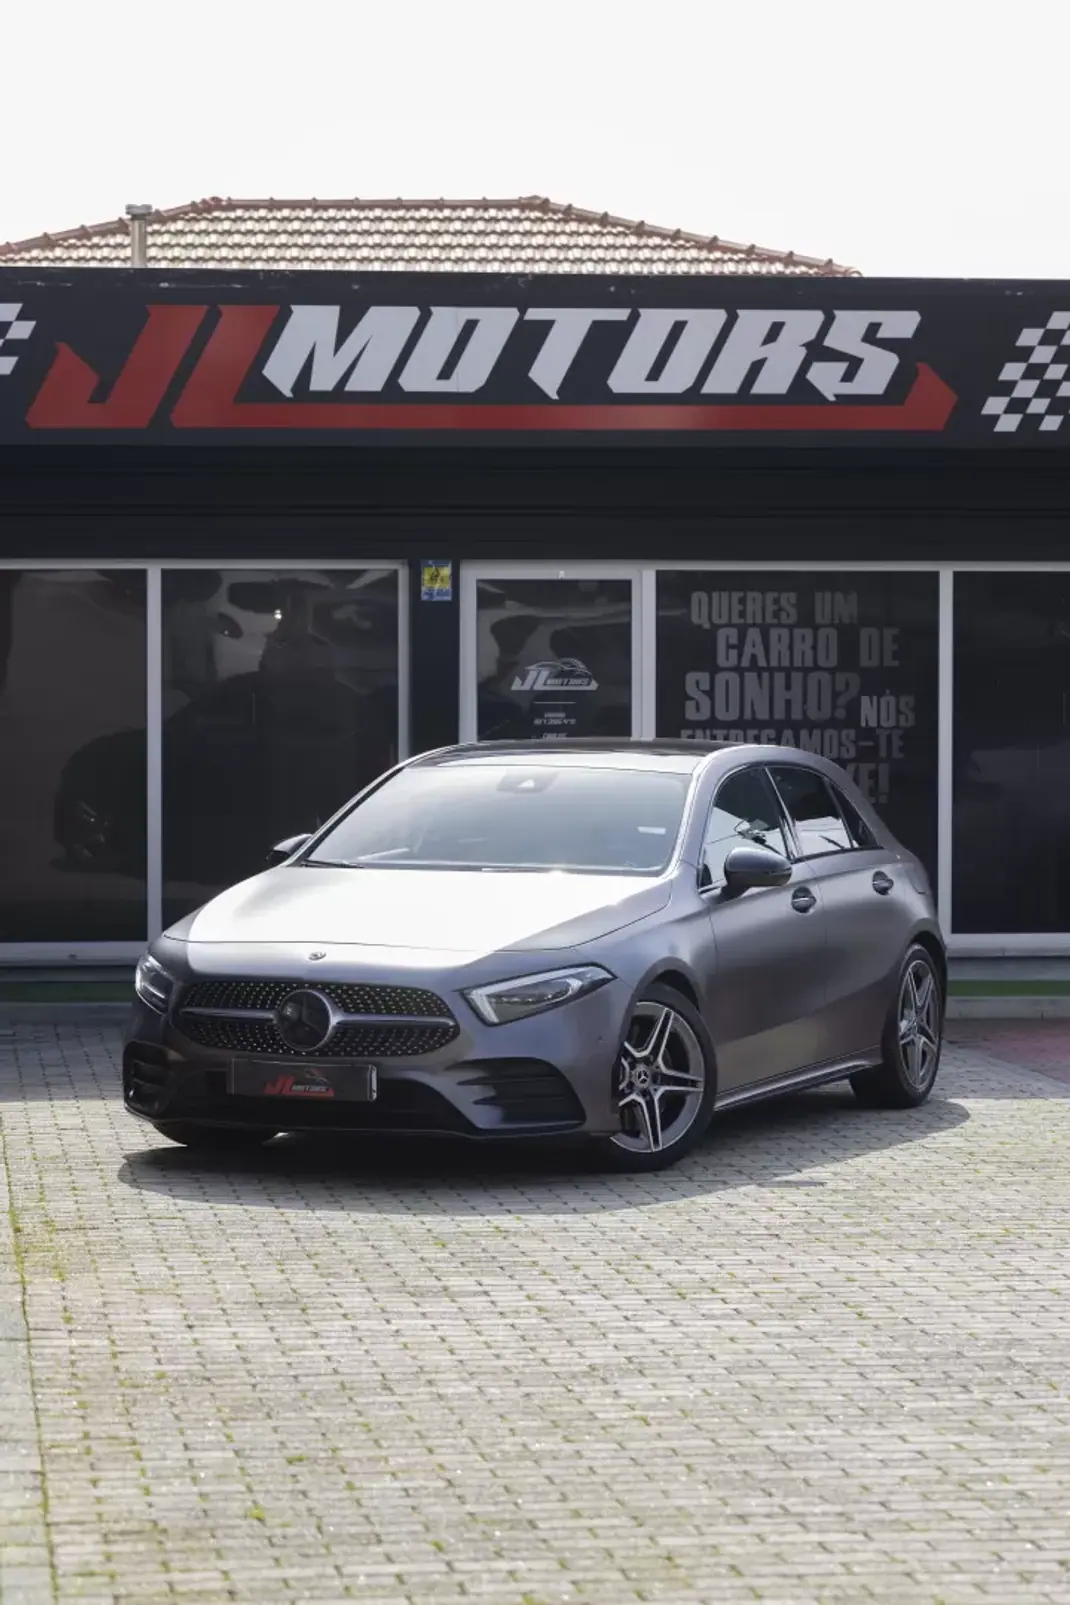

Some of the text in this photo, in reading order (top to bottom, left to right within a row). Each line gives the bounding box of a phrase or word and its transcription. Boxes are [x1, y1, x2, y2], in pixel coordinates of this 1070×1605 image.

[690, 591, 858, 629] QUERES UM
[716, 626, 900, 668] CARRO DE
[684, 671, 861, 721] SONHO?
[860, 689, 915, 728] NÓS
